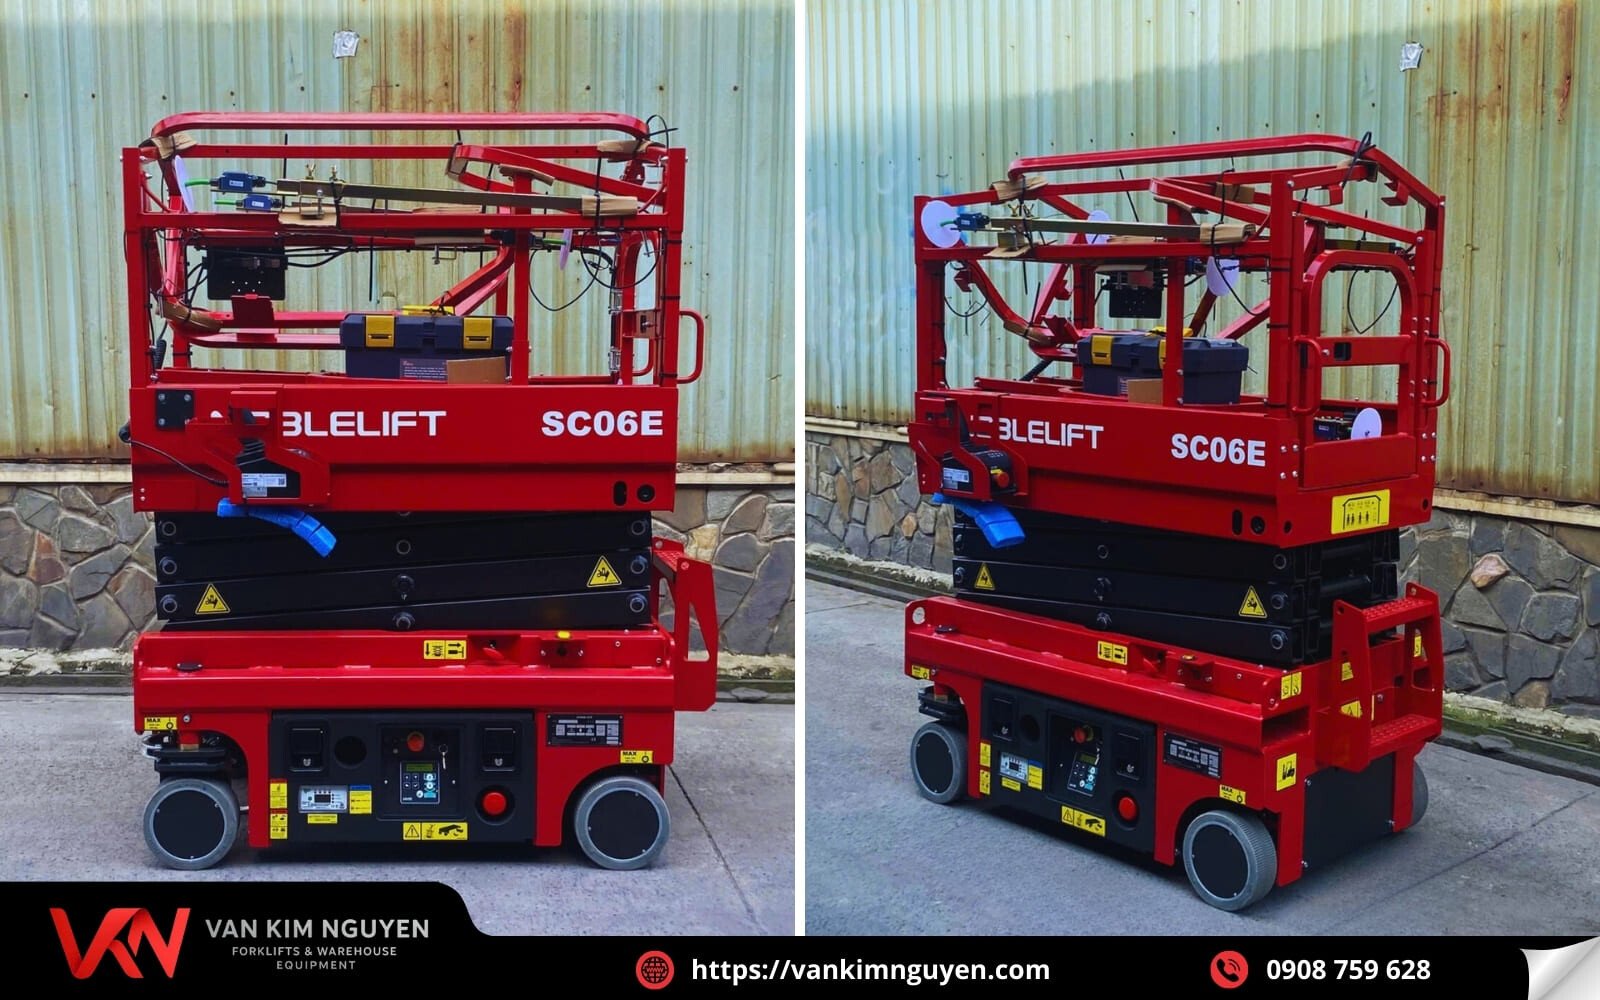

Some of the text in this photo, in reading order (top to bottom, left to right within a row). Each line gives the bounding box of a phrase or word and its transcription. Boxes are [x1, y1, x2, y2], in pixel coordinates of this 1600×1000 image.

[210, 410, 447, 437] BLELIFT
[541, 410, 664, 437] SC06E
[969, 415, 1105, 450] BLELIFT
[1171, 433, 1266, 467] SC06E
